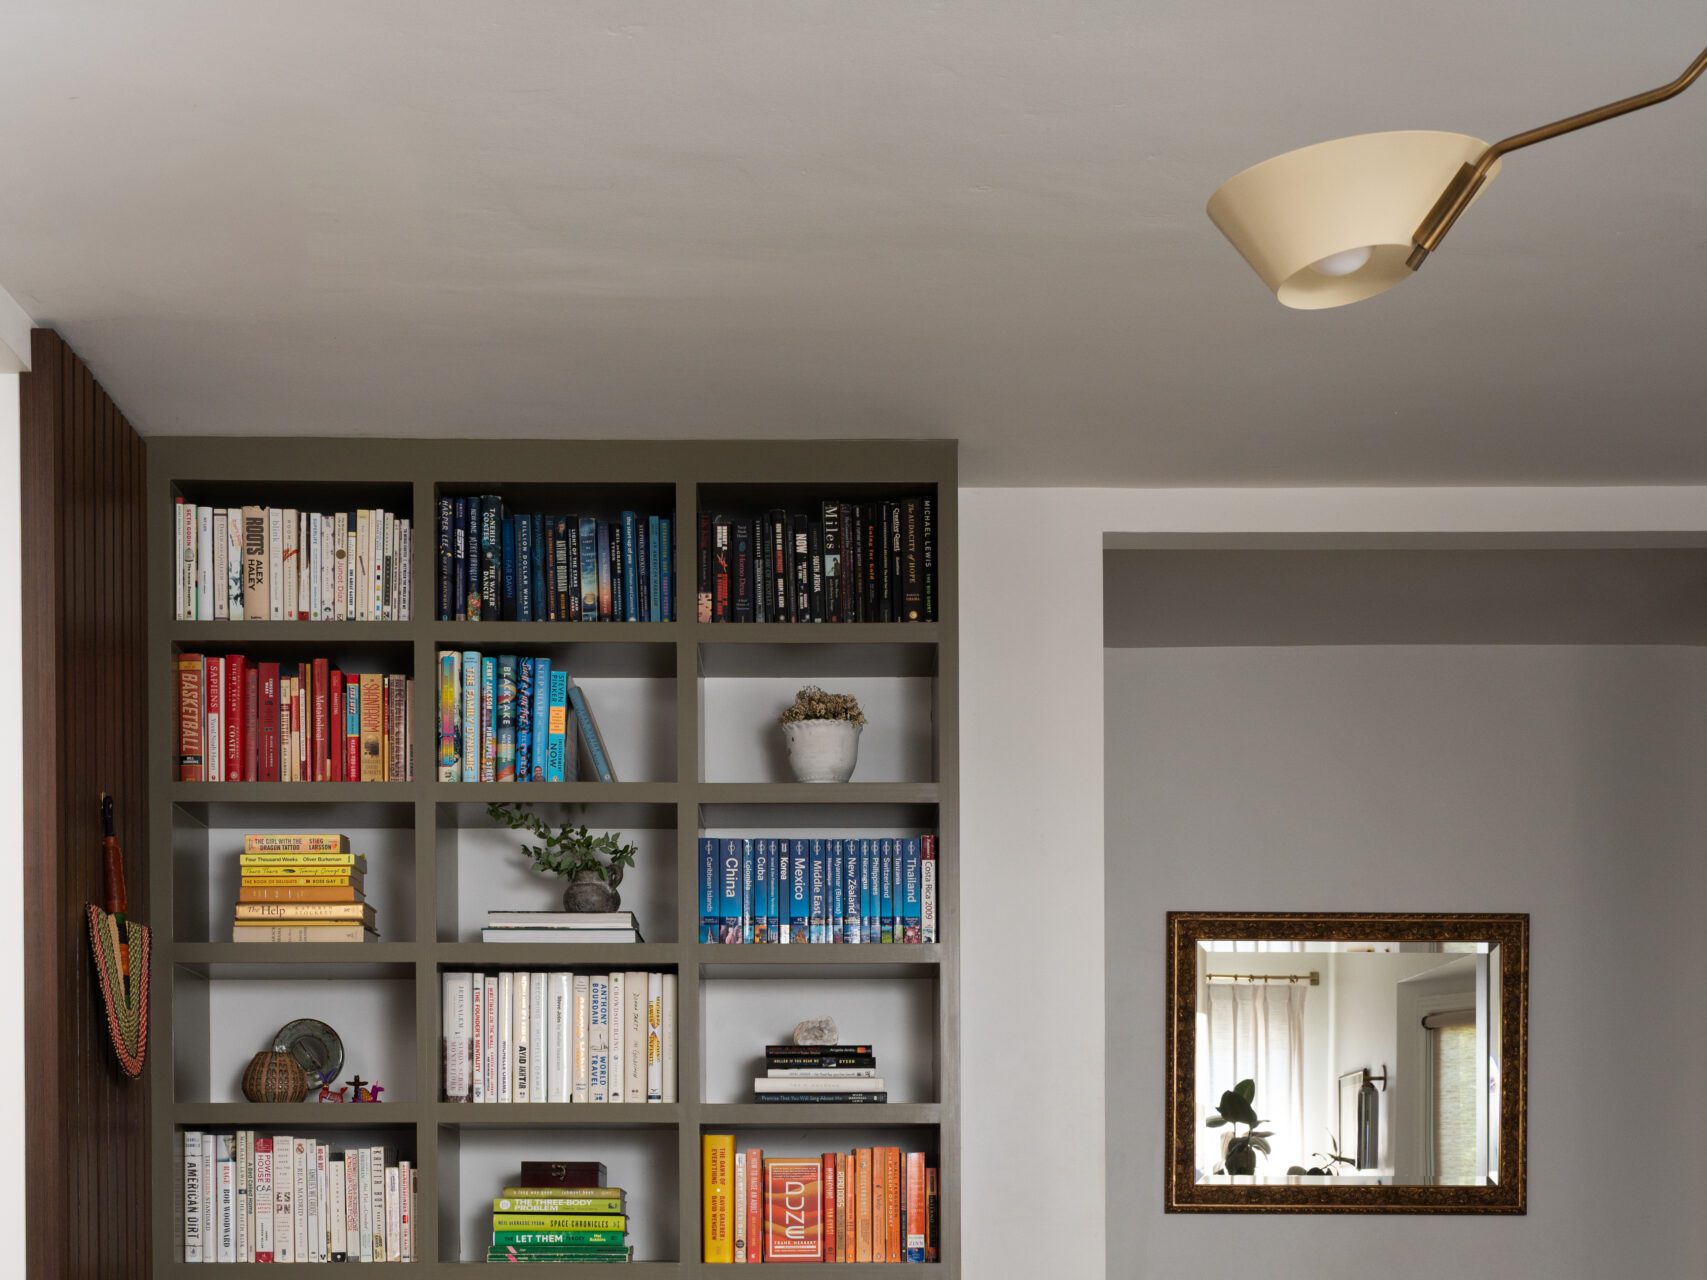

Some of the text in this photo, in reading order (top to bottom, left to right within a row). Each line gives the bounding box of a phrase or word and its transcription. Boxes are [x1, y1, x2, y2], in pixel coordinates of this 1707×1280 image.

[246, 517, 264, 555] ROOTS
[272, 520, 280, 542] blink
[796, 533, 807, 553] NOW
[825, 506, 838, 549] Miles
[210, 666, 218, 708] SAPIENS
[503, 666, 511, 696] BLACK
[182, 673, 199, 751] BASKETBALL
[316, 695, 324, 740] Metabolical
[363, 683, 380, 732] SHANTARAM
[466, 668, 474, 770] THE FAMILY DYNAMIC
[726, 858, 738, 897] China
[780, 857, 788, 880] Korea
[795, 858, 805, 900] Mexico
[814, 860, 822, 914] Middle East
[907, 857, 916, 902] Thailand
[261, 906, 286, 917] Help
[848, 879, 856, 913] Zealand
[187, 1162, 199, 1239] AMERICAN DIRT
